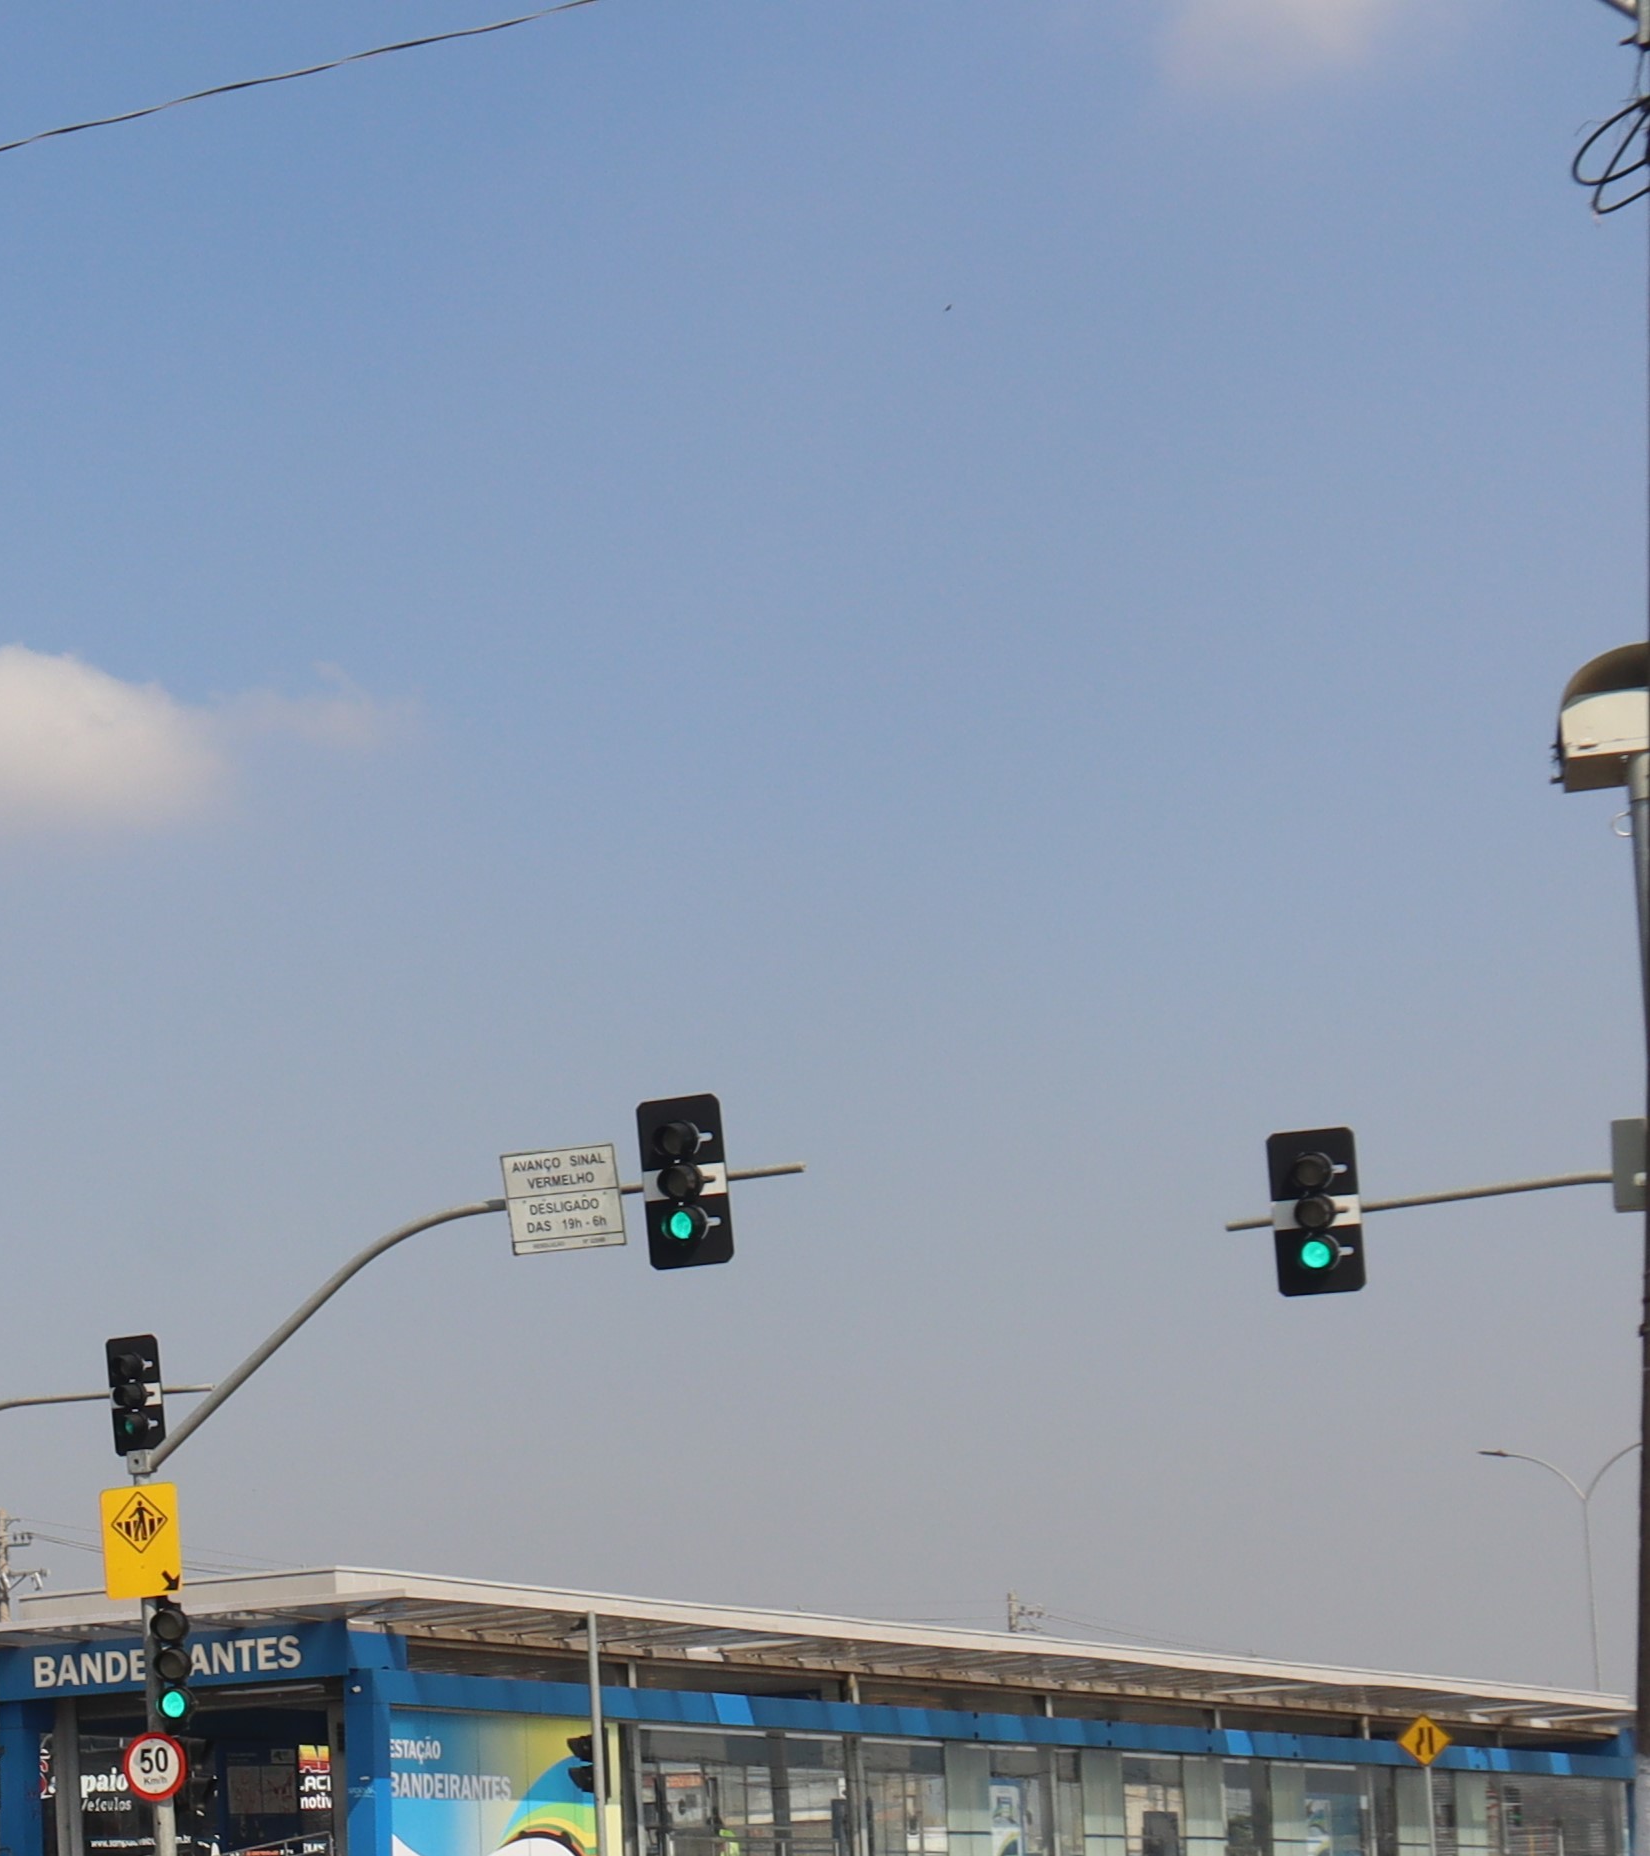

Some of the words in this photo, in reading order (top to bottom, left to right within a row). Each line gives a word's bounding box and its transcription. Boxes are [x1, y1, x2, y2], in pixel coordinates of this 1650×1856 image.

[511, 1157, 561, 1174] AVANÇO
[569, 1153, 606, 1167] SINAL
[527, 1171, 595, 1189] VERMELHO
[529, 1198, 599, 1216] DESLIGADO
[526, 1220, 552, 1234] DAS
[562, 1218, 582, 1230] 19h
[592, 1215, 607, 1227] 6h
[33, 1635, 302, 1688] BANDEANTES
[140, 1746, 169, 1774] 50
[390, 1736, 441, 1765] ESTAÇÃO
[143, 1776, 169, 1786] Km/h
[391, 1771, 512, 1801] BANDEIRANTES
